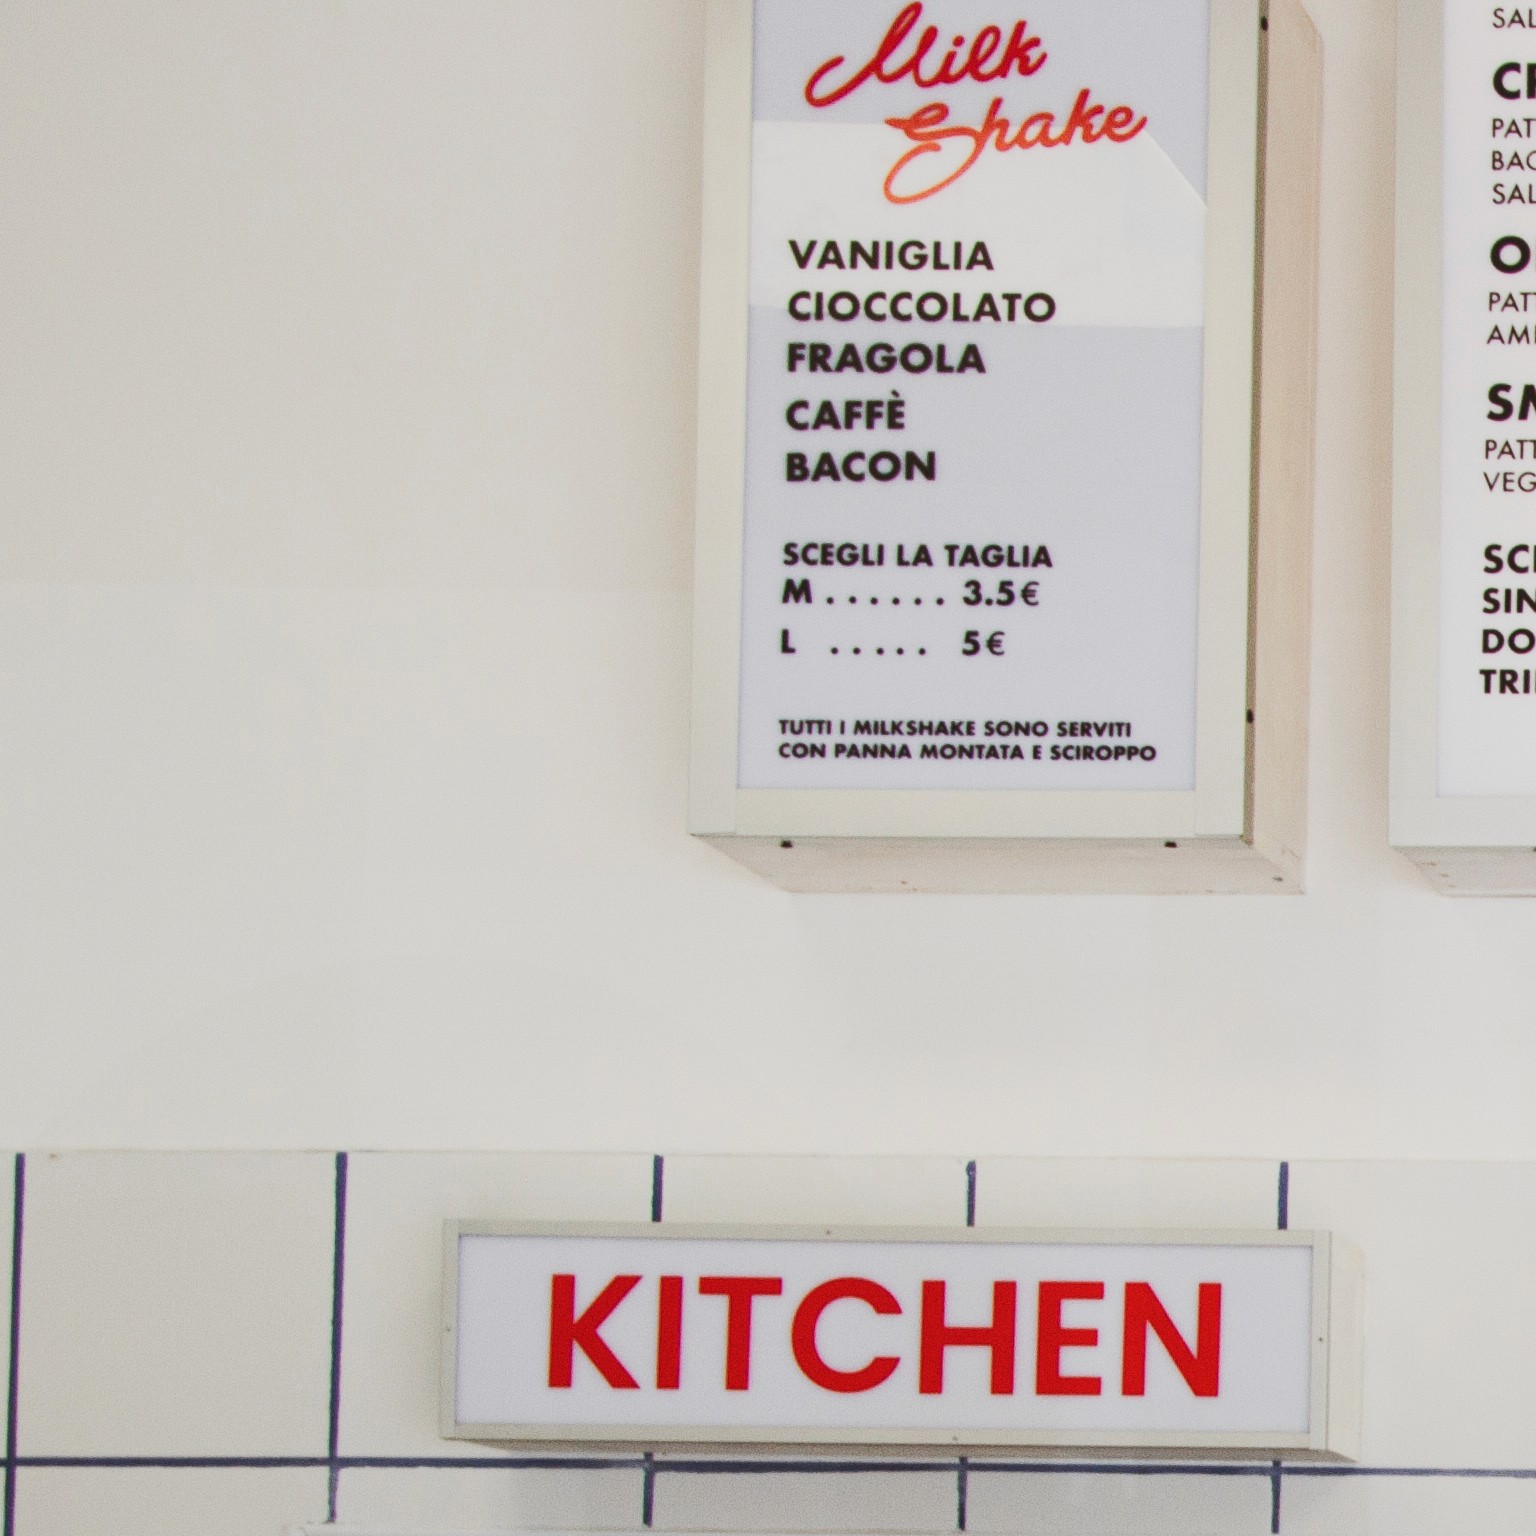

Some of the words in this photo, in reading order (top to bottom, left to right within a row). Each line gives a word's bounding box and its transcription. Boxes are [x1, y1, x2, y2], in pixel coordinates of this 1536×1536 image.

[803, 1, 1048, 108] Milk
[881, 88, 1149, 206] Shake
[788, 239, 995, 272] VANIGLIA
[787, 290, 1057, 324] CIOCCOLATO
[787, 342, 987, 375] FRAGOLA
[785, 389, 906, 432] CAFFÈ
[786, 450, 937, 483] BACON
[783, 541, 885, 568] SCEGLI
[896, 543, 934, 568] LA
[943, 543, 1053, 569] TAGLIA
[778, 719, 833, 736] TUTTI
[853, 719, 976, 737] MILKSHAKE
[984, 720, 1050, 738] SONO
[1057, 721, 1132, 738] SERVITI
[778, 742, 827, 760] CON
[834, 742, 913, 760] PANNA
[919, 743, 1025, 761] MONTATA
[1050, 744, 1157, 762] SCIROPPO
[547, 1273, 1223, 1398] KITCHEN
